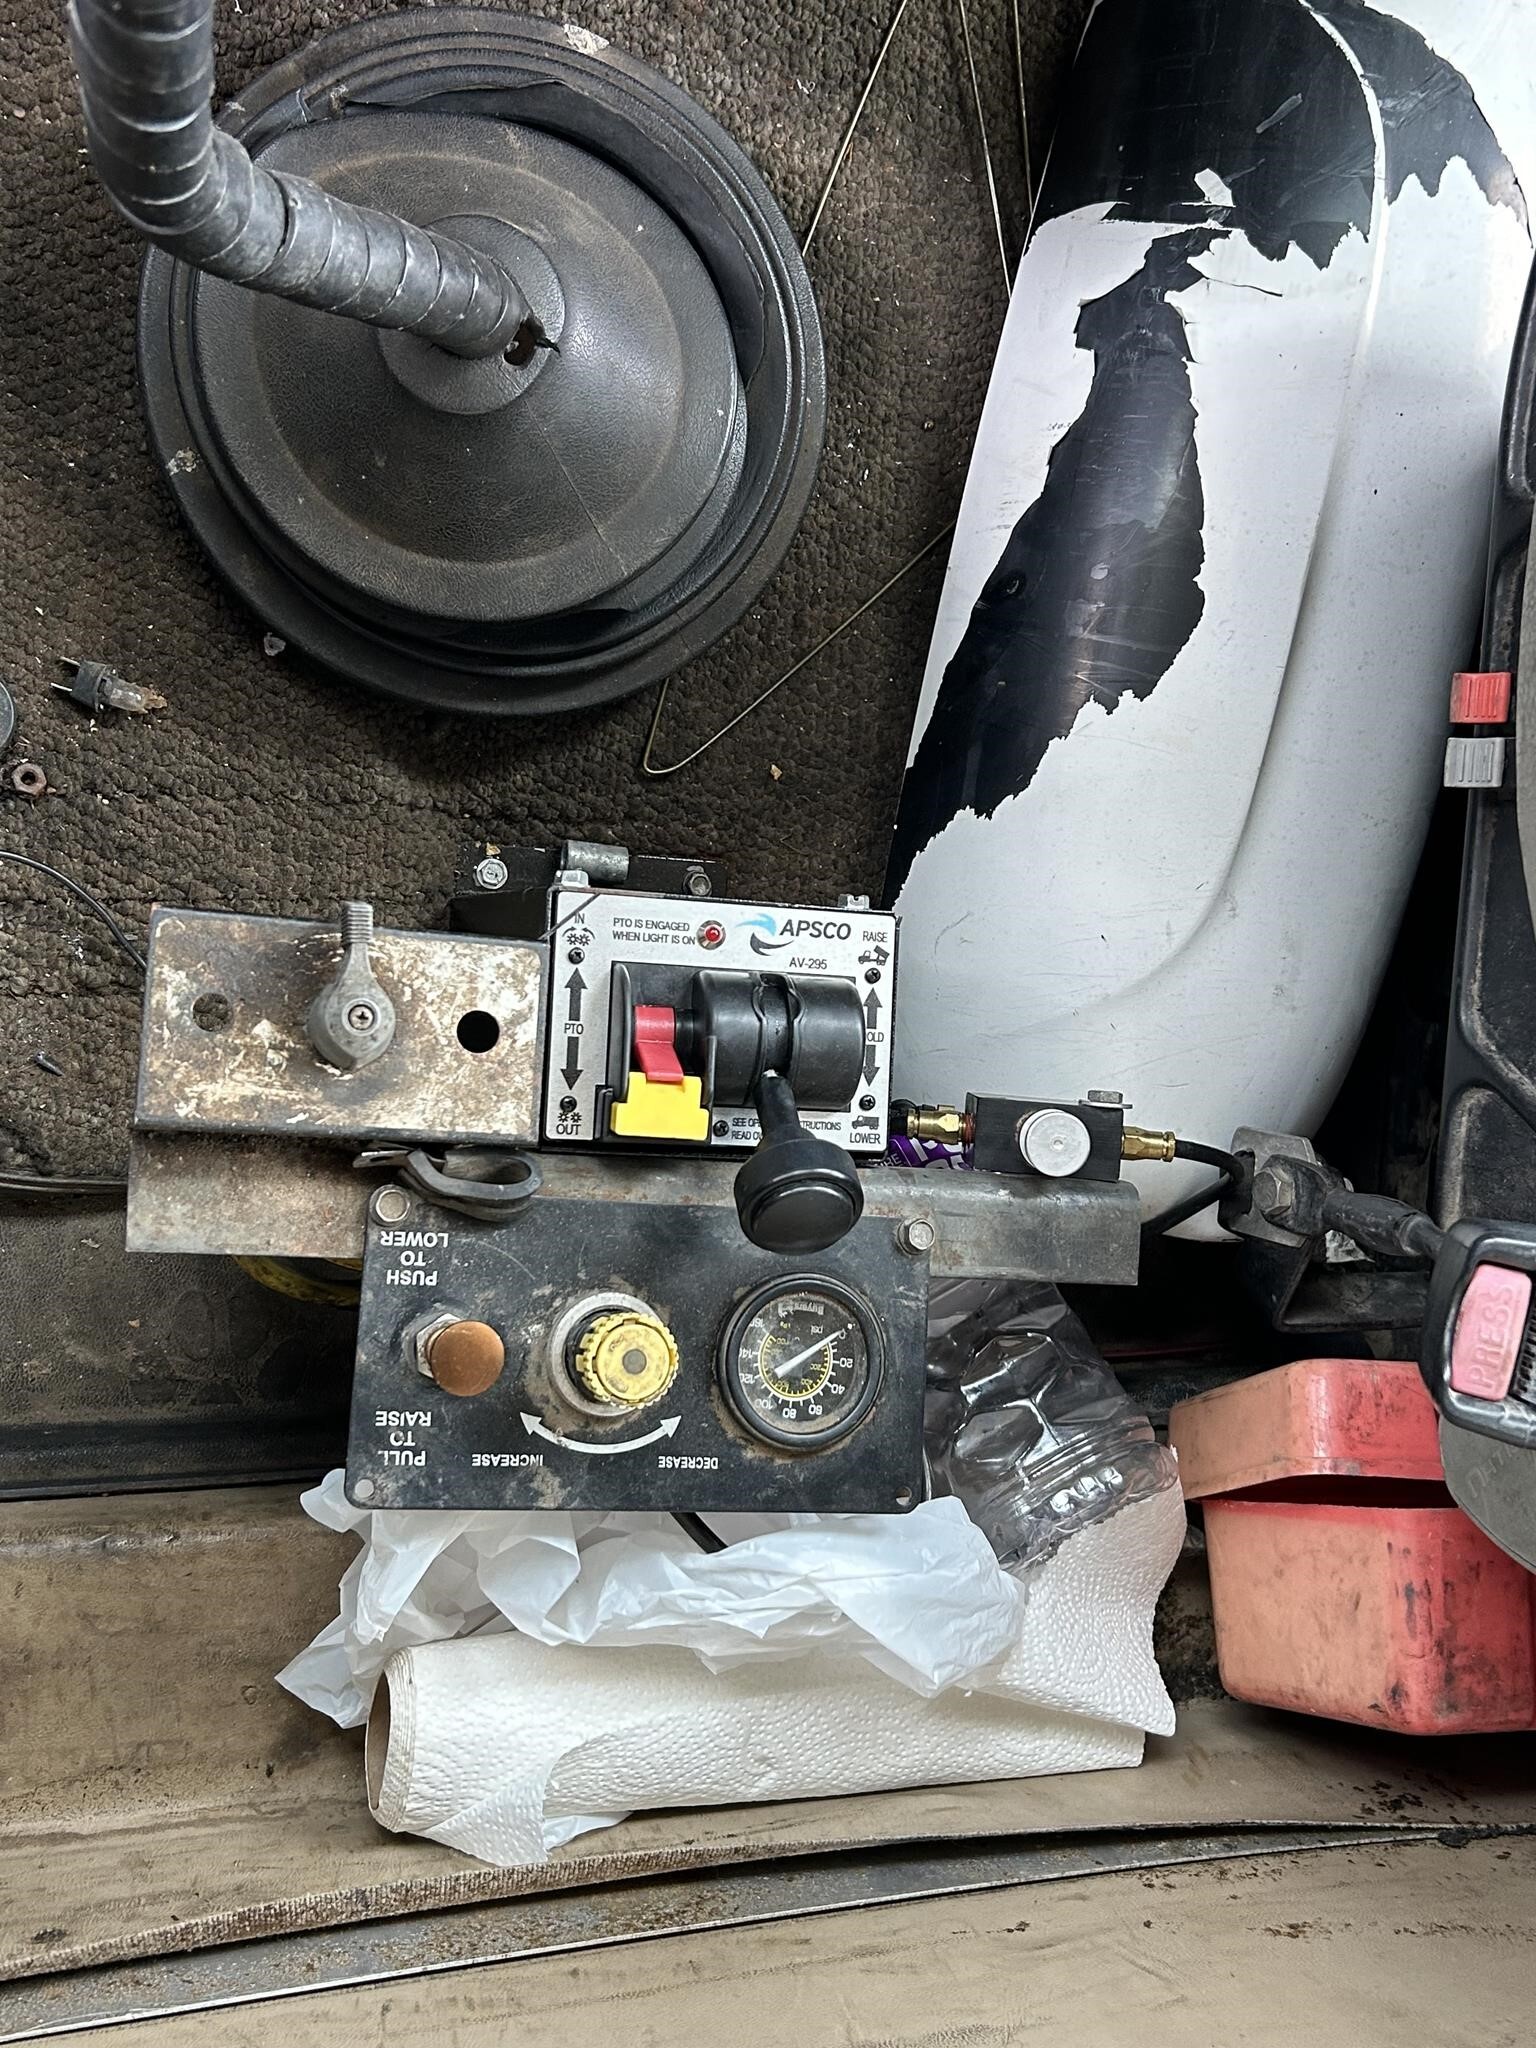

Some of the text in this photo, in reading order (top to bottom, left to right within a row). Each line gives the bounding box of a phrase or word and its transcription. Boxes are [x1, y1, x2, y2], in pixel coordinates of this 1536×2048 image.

[574, 912, 585, 924] IN
[613, 917, 689, 931] PTO IS ENGAGED
[779, 919, 851, 940] APSCO
[612, 930, 696, 945] WHEN LIGHT IS ON
[863, 930, 887, 943] RAISE
[789, 957, 827, 969] AV-295
[564, 1023, 584, 1035] PTO
[867, 1031, 884, 1043] OLD
[732, 1117, 747, 1127] SEE
[556, 1123, 581, 1136] OUT
[731, 1130, 752, 1140] READ
[850, 1132, 881, 1145] LOWER
[380, 1230, 449, 1248] LOWER
[400, 1250, 426, 1266] TO
[386, 1269, 438, 1286] PUSH
[811, 1324, 823, 1335] psi
[1466, 1283, 1516, 1392] PRESS
[839, 1358, 853, 1368] 20
[830, 1383, 845, 1395] 40
[754, 1398, 775, 1411] 100
[808, 1404, 823, 1416] 60
[375, 1410, 432, 1427] RAISE
[782, 1408, 797, 1419] 80
[390, 1430, 416, 1447] TO
[378, 1450, 426, 1467] PULL
[472, 1453, 544, 1467] INCREASE
[658, 1455, 719, 1469] DECREASE
